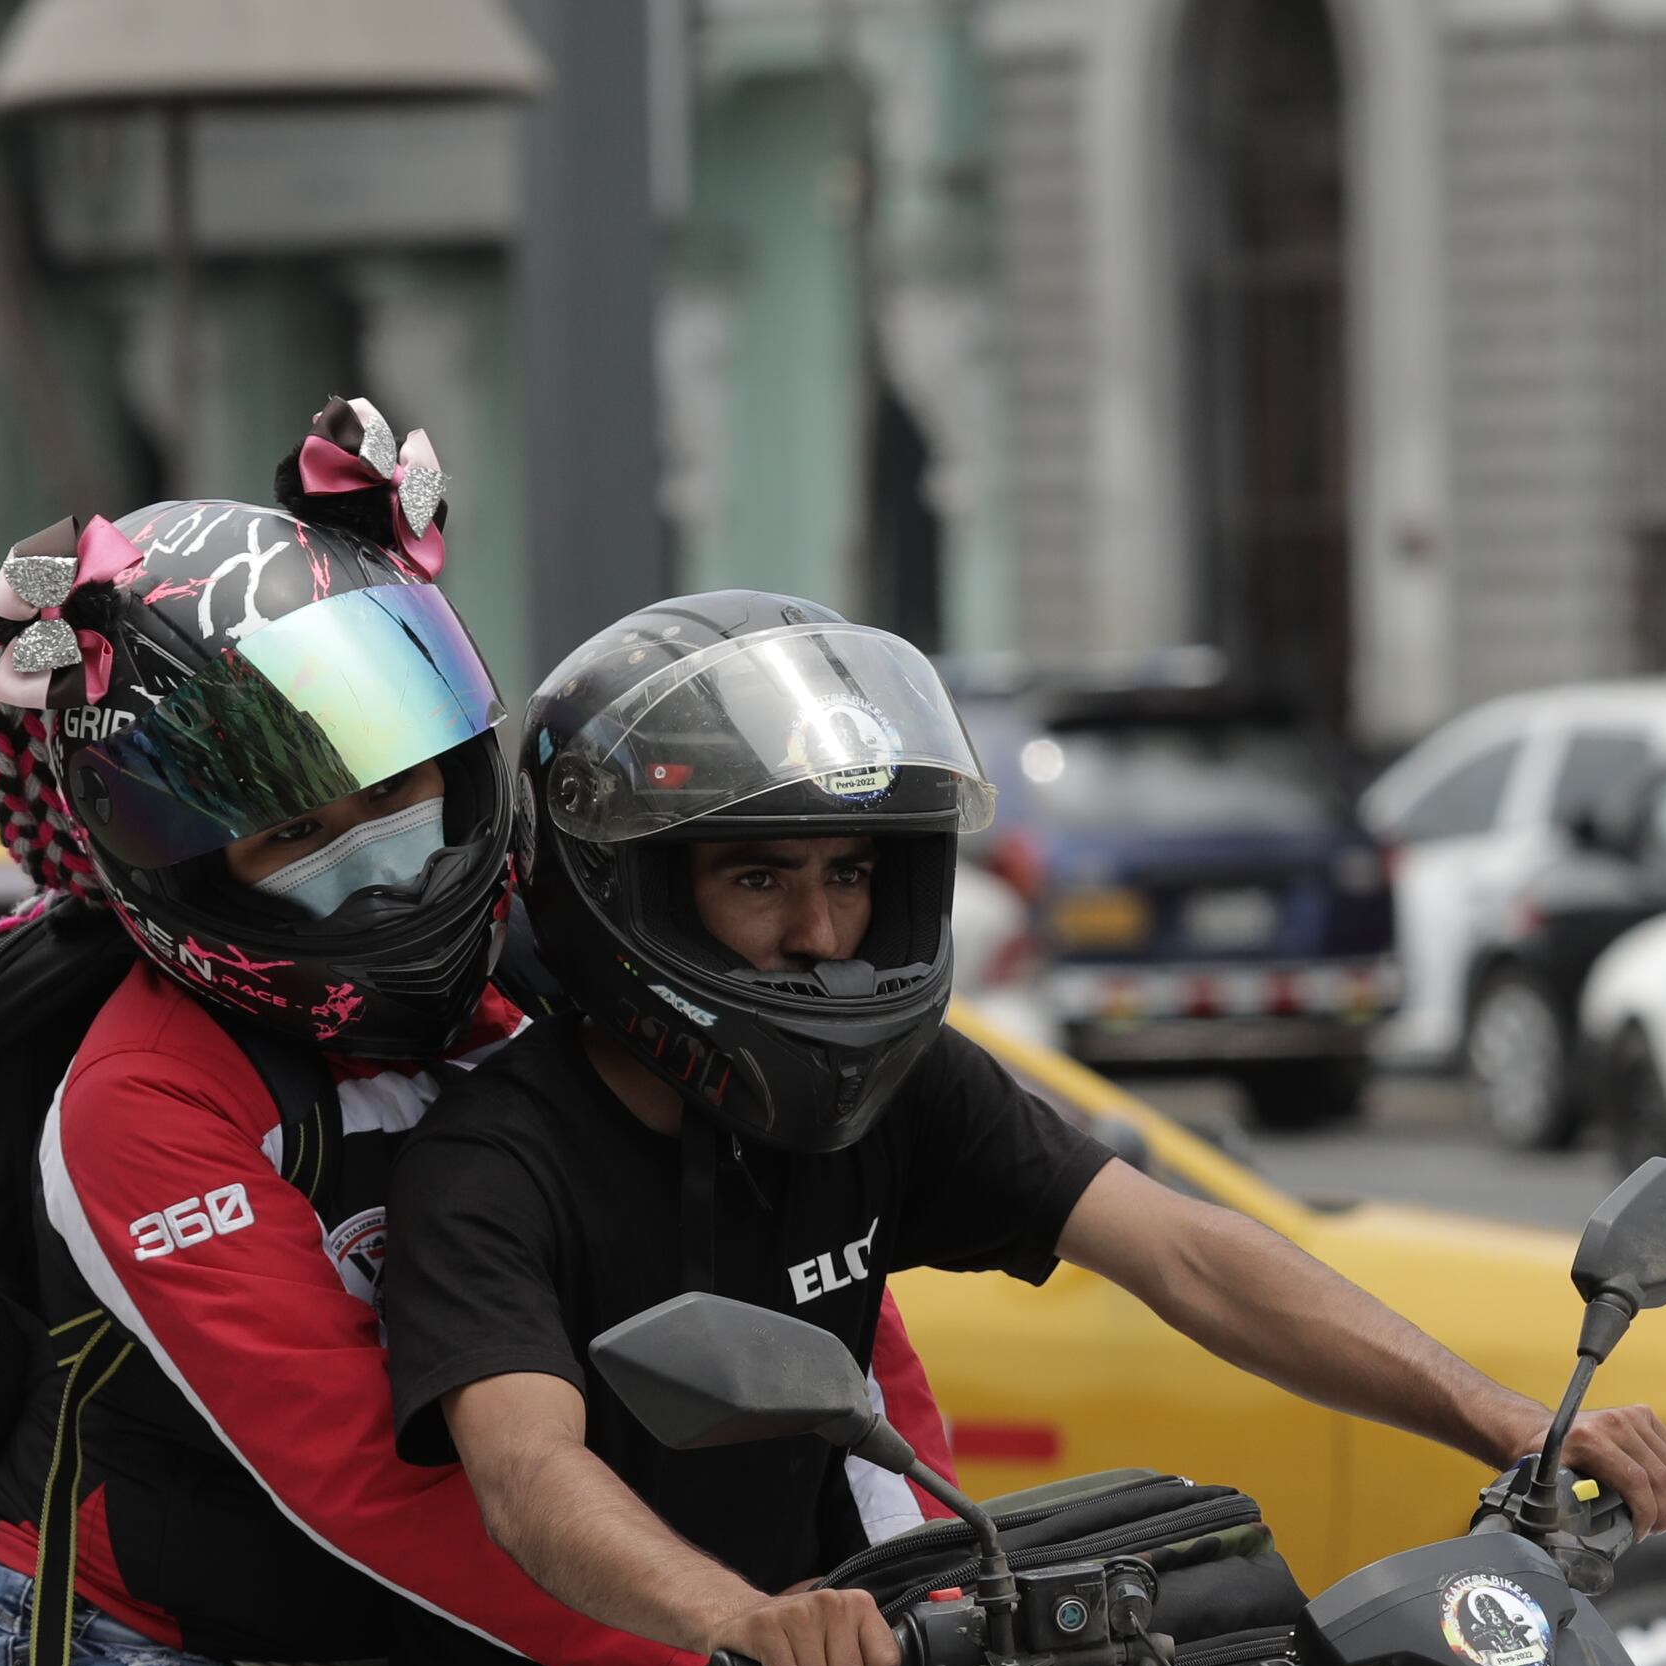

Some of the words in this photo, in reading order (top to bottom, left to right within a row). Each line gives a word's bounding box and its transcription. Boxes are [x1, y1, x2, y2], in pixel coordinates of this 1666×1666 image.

[221, 974, 288, 1008] RACE
[128, 1182, 256, 1262] 360
[335, 1240, 344, 1251] DE
[345, 1218, 382, 1239] VIAJEROS
